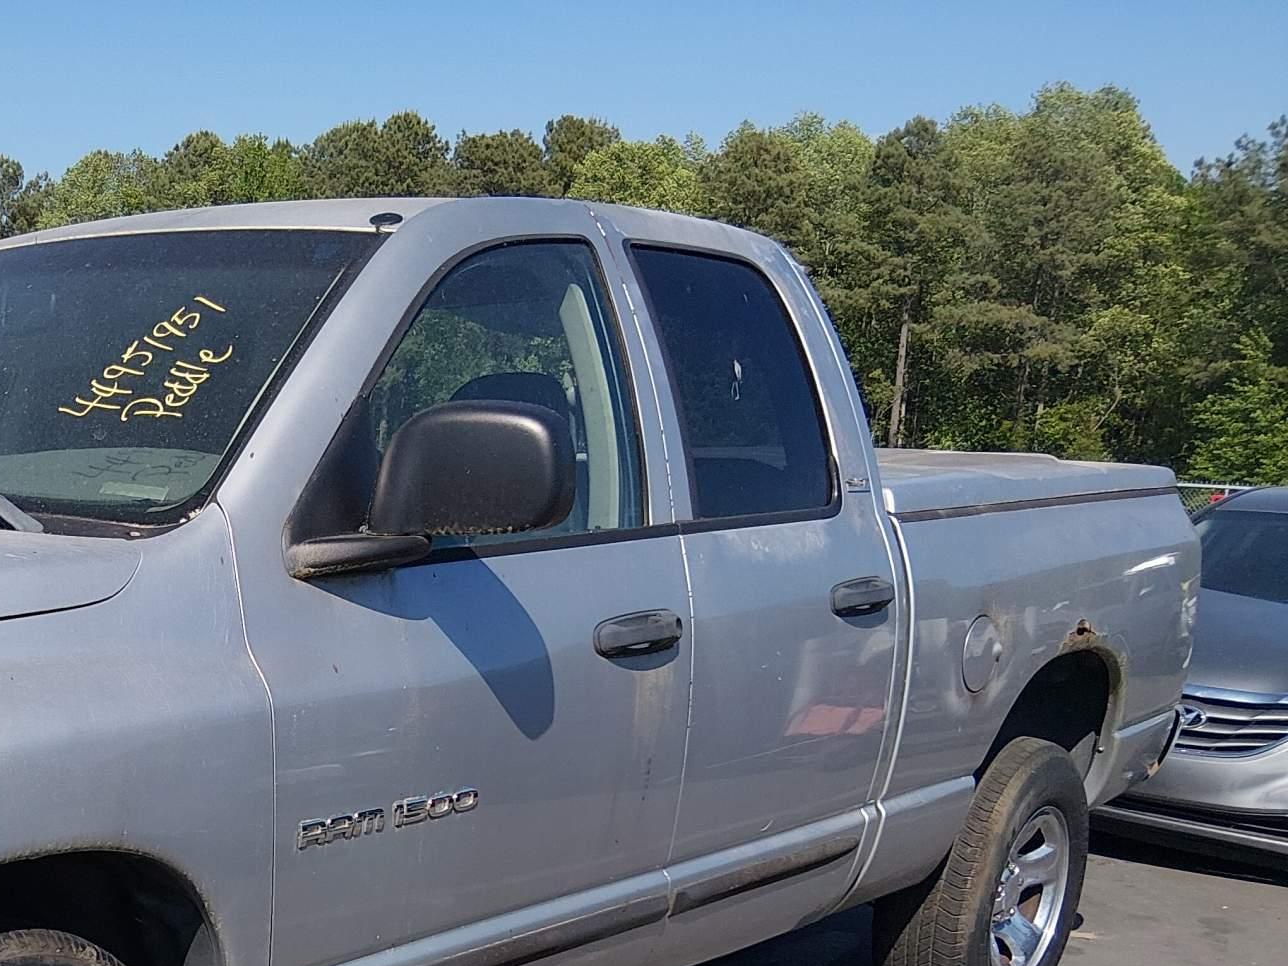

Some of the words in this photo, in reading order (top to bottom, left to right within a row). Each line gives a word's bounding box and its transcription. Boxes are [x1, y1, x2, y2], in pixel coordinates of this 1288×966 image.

[58, 295, 227, 417] 44951951
[295, 806, 386, 851] RAM
[391, 787, 480, 829] 1500
